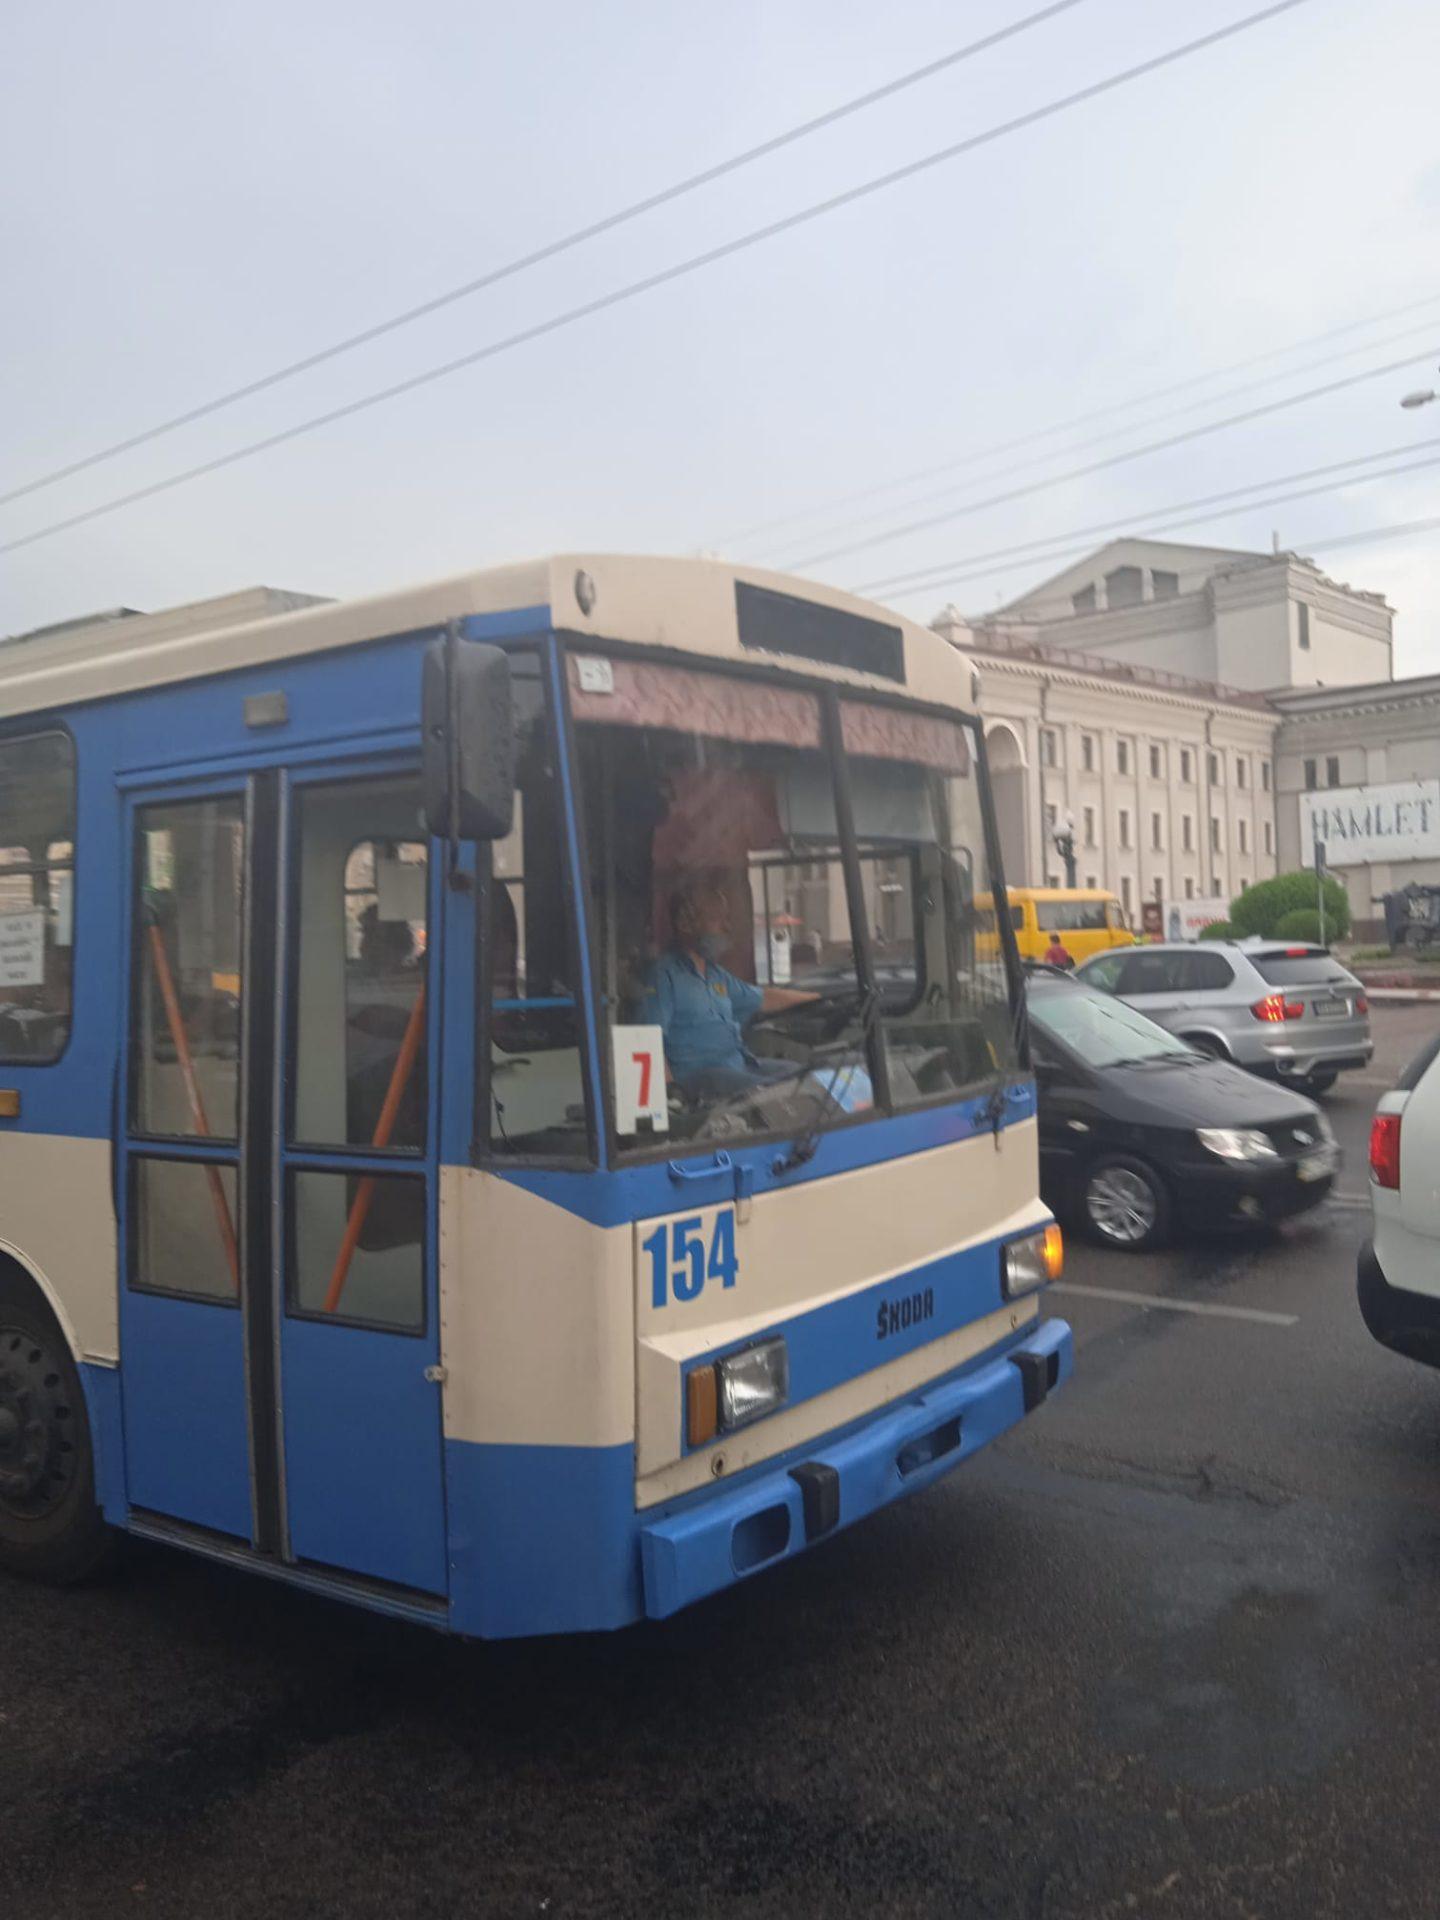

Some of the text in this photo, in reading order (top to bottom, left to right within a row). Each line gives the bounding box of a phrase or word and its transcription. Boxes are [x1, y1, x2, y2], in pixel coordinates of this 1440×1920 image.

[1311, 799, 1433, 840] HAMLET
[632, 1052, 651, 1107] 7
[642, 1208, 739, 1309] 154
